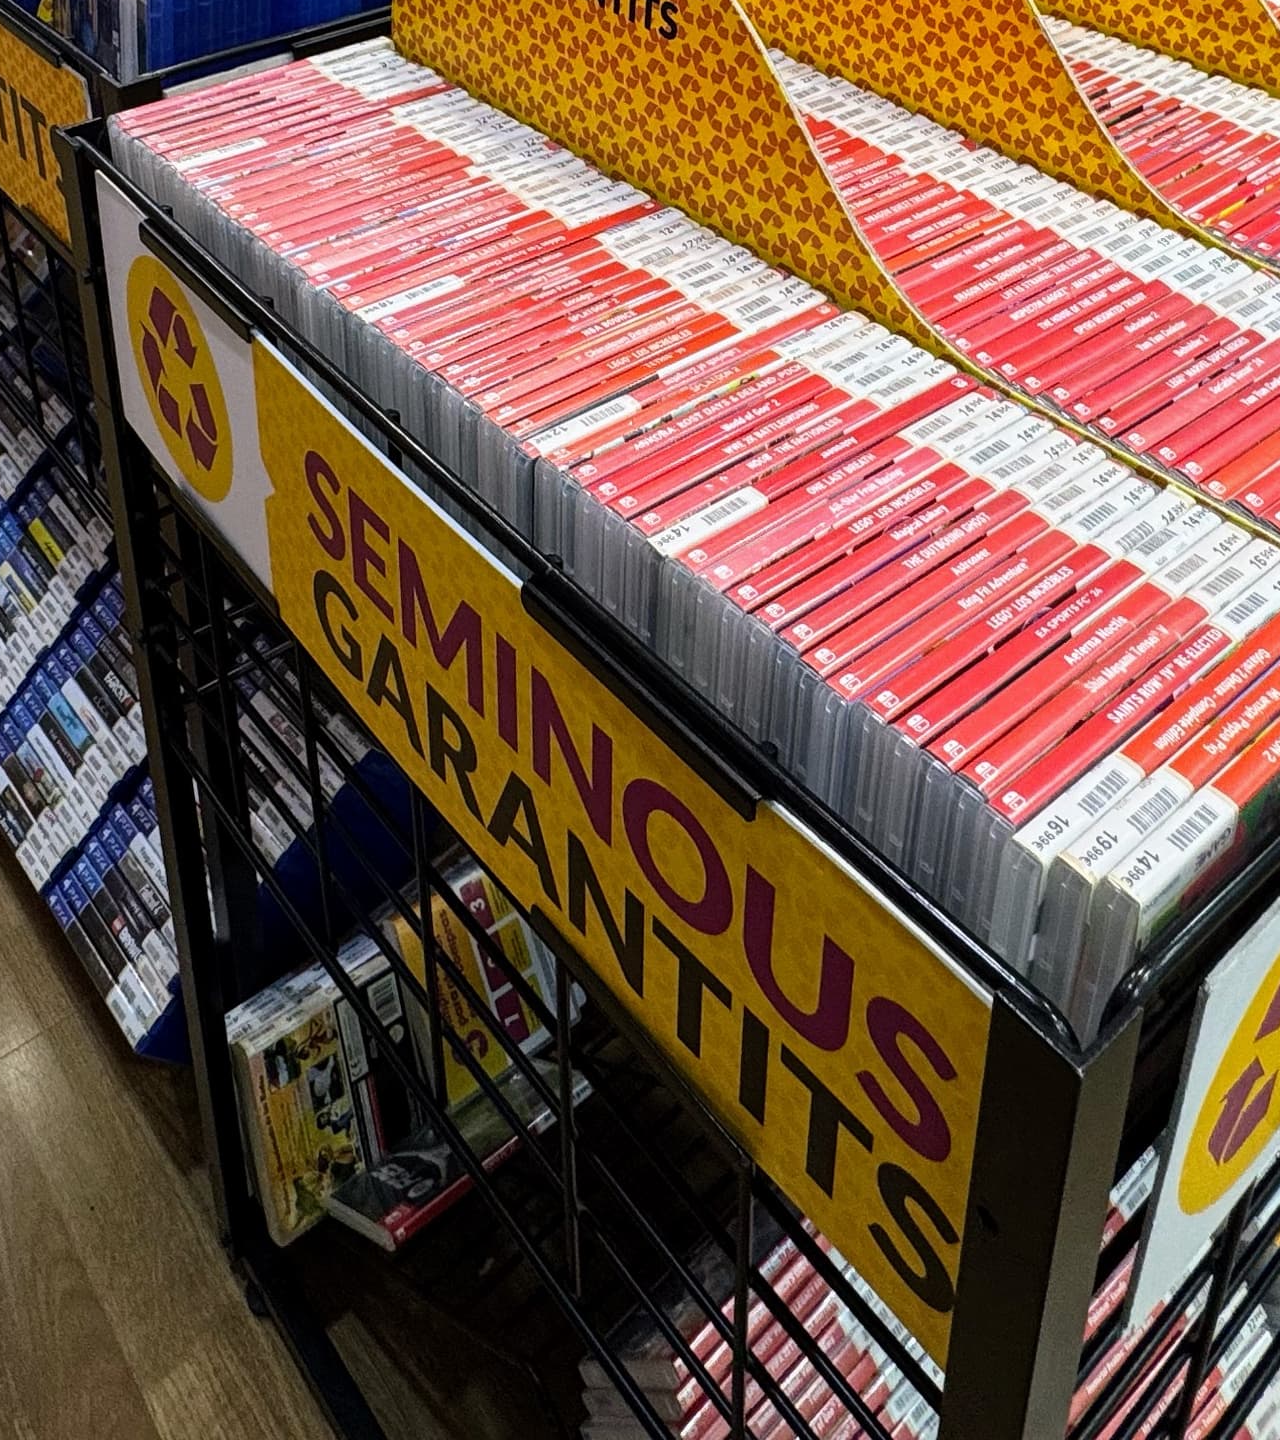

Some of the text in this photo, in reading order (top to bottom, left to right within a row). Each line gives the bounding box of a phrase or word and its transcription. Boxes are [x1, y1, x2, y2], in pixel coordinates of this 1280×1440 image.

[806, 454, 877, 495] ONE LAST BREATH
[848, 515, 874, 534] LEGO
[873, 504, 892, 520] LOS
[901, 553, 921, 569] THE
[957, 590, 983, 610] Ring
[987, 608, 1014, 630] LEGO
[1011, 594, 1031, 612] LOS
[1083, 671, 1107, 693] Shin
[1101, 650, 1136, 682] Megami
[1132, 628, 1162, 659] Tensei
[1107, 692, 1146, 725] SAINTS
[1140, 673, 1163, 701] ROW
[1173, 628, 1224, 670] RE-ELECTED
[304, 449, 959, 1163] SEMINOUS
[313, 570, 962, 1313] GARANTITS
